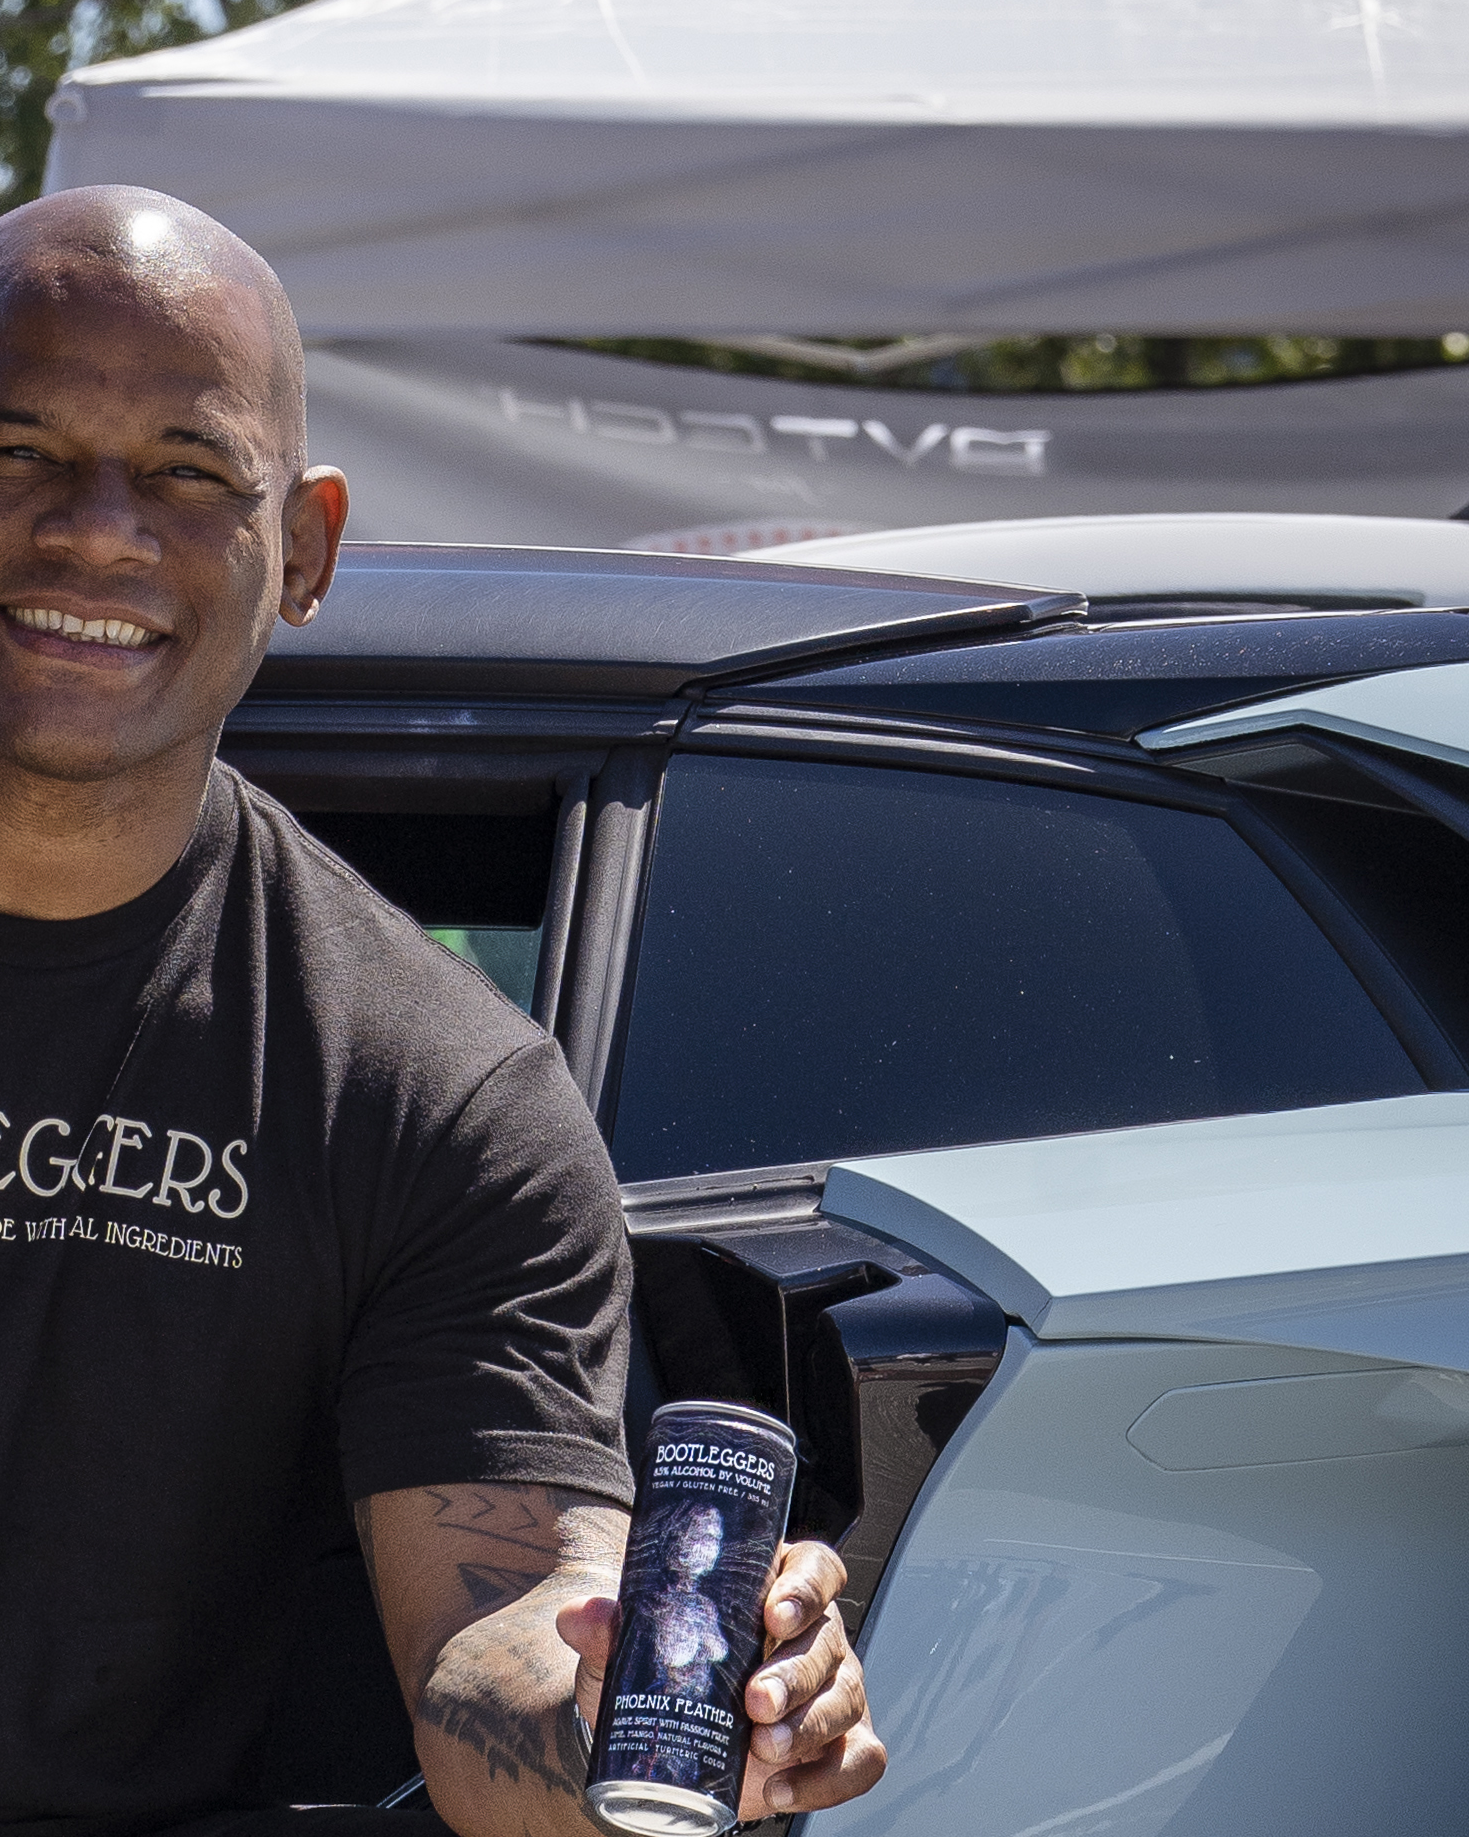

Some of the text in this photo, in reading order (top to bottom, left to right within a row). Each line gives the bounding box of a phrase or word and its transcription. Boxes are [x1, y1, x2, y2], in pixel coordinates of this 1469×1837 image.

[105, 1222, 242, 1268] INGREDIENTS
[656, 1444, 775, 1481] BOOTLEGGERS
[671, 1466, 716, 1478] ALCOHOL
[718, 1469, 733, 1481] BY
[735, 1473, 771, 1495] VOLUME
[682, 1481, 715, 1491] GLUTEN
[718, 1484, 739, 1496] FREE
[614, 1694, 734, 1729] PHOENIX FEATHER
[656, 1732, 691, 1745] NATURAL
[658, 1718, 679, 1730] WITH
[680, 1722, 711, 1738] PASSION
